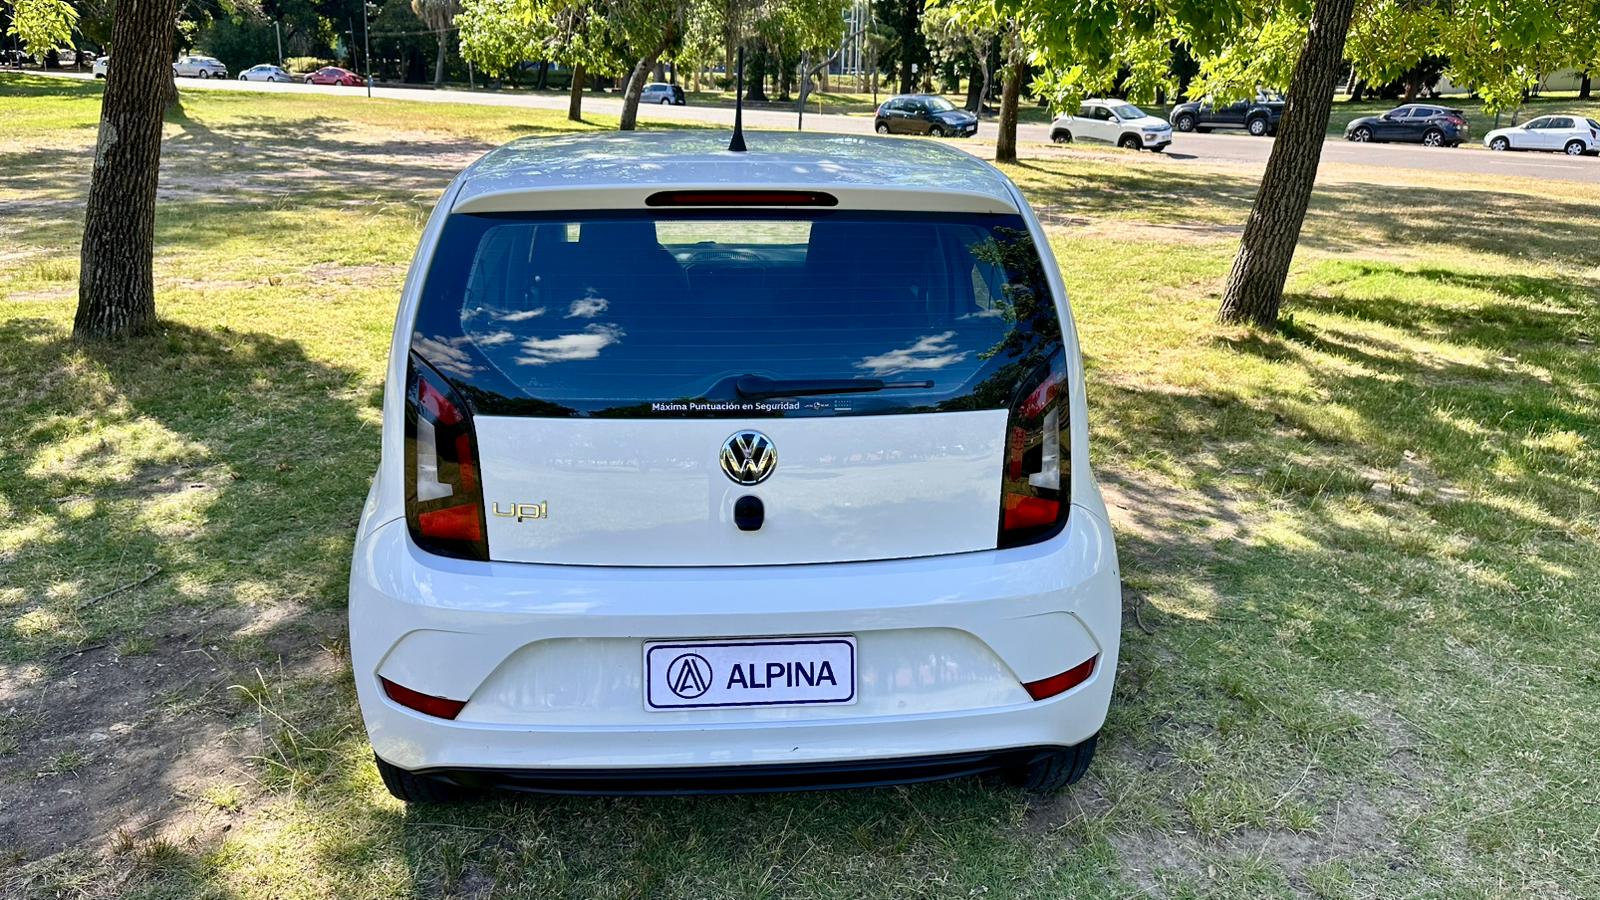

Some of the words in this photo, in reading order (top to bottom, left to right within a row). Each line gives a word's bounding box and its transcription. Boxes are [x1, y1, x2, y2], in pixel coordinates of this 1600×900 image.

[652, 402, 687, 411] Máxima
[689, 402, 740, 411] Puntuación
[755, 402, 800, 412] Seguridad
[492, 500, 547, 522] up!
[726, 660, 837, 690] ALPINA
